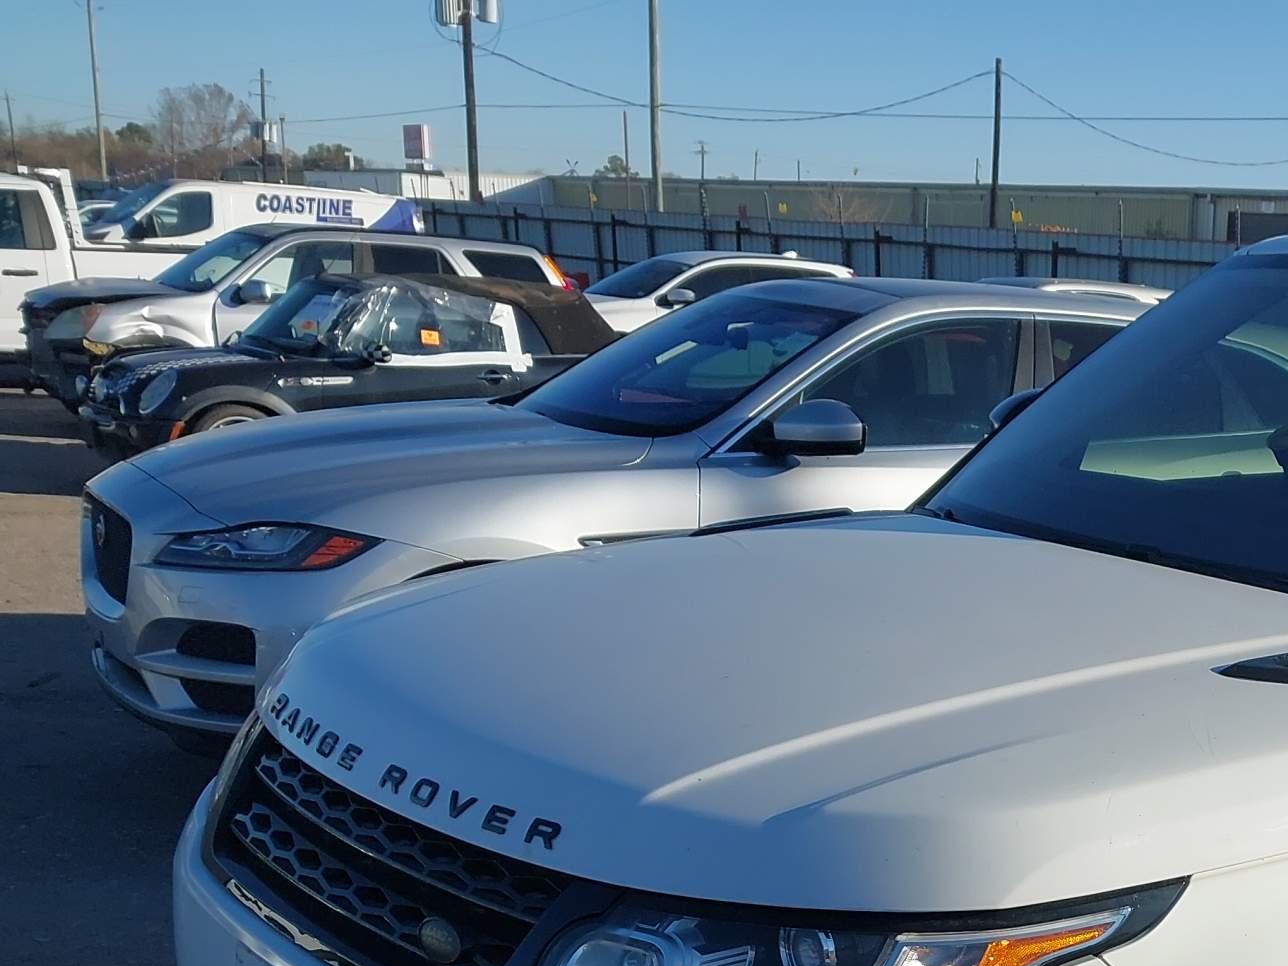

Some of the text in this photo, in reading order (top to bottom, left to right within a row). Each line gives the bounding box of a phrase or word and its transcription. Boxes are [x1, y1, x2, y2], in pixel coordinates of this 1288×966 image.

[256, 193, 353, 221] COASTLINE
[270, 692, 562, 850] RANGE ROVER
